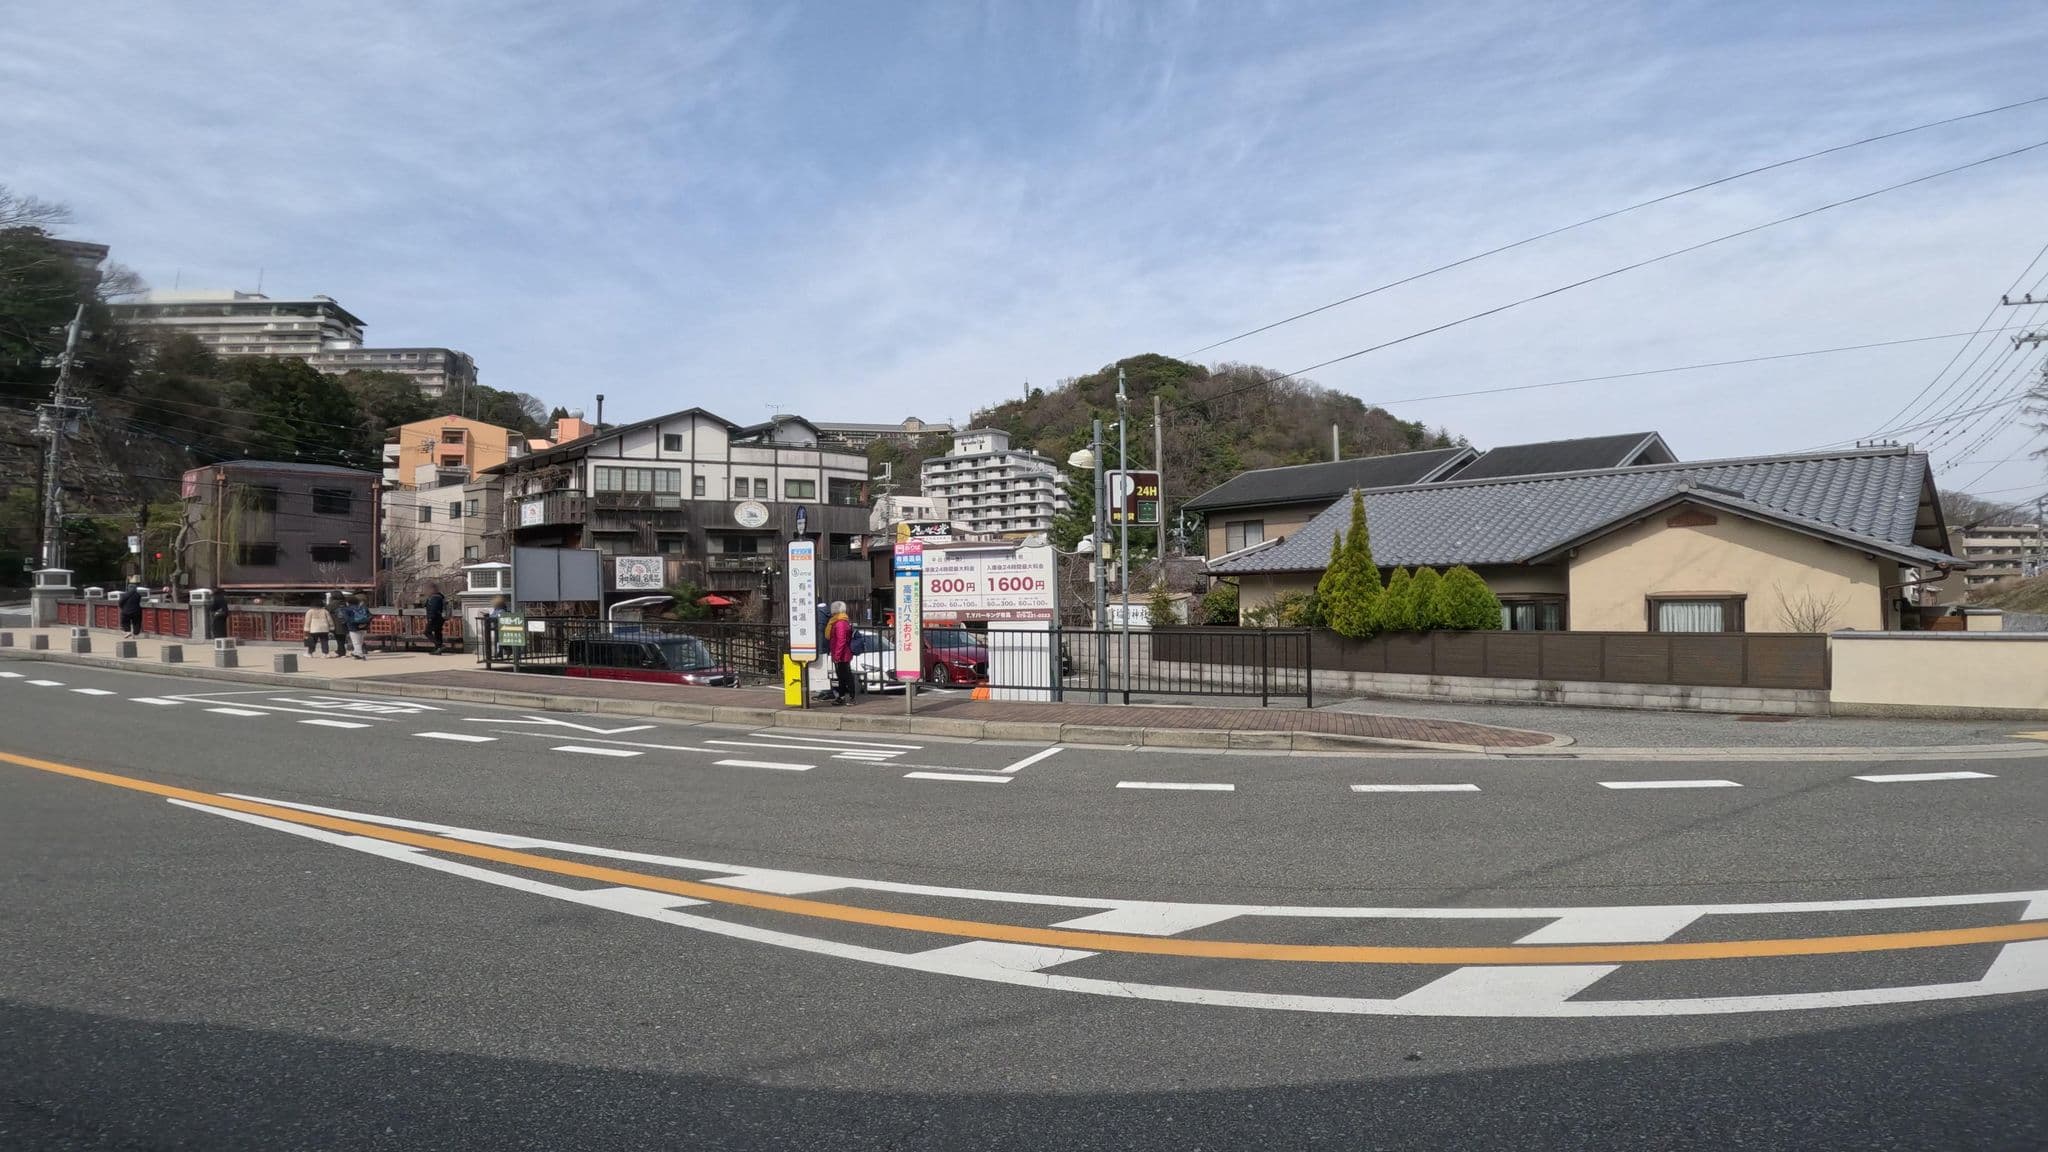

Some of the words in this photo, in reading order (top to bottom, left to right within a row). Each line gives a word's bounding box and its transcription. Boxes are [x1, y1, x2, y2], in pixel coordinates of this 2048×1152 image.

[1136, 486, 1157, 497] 24H
[931, 579, 976, 593] 800円
[987, 576, 1045, 592] 1600円
[903, 585, 912, 651] 高速バスおりば
